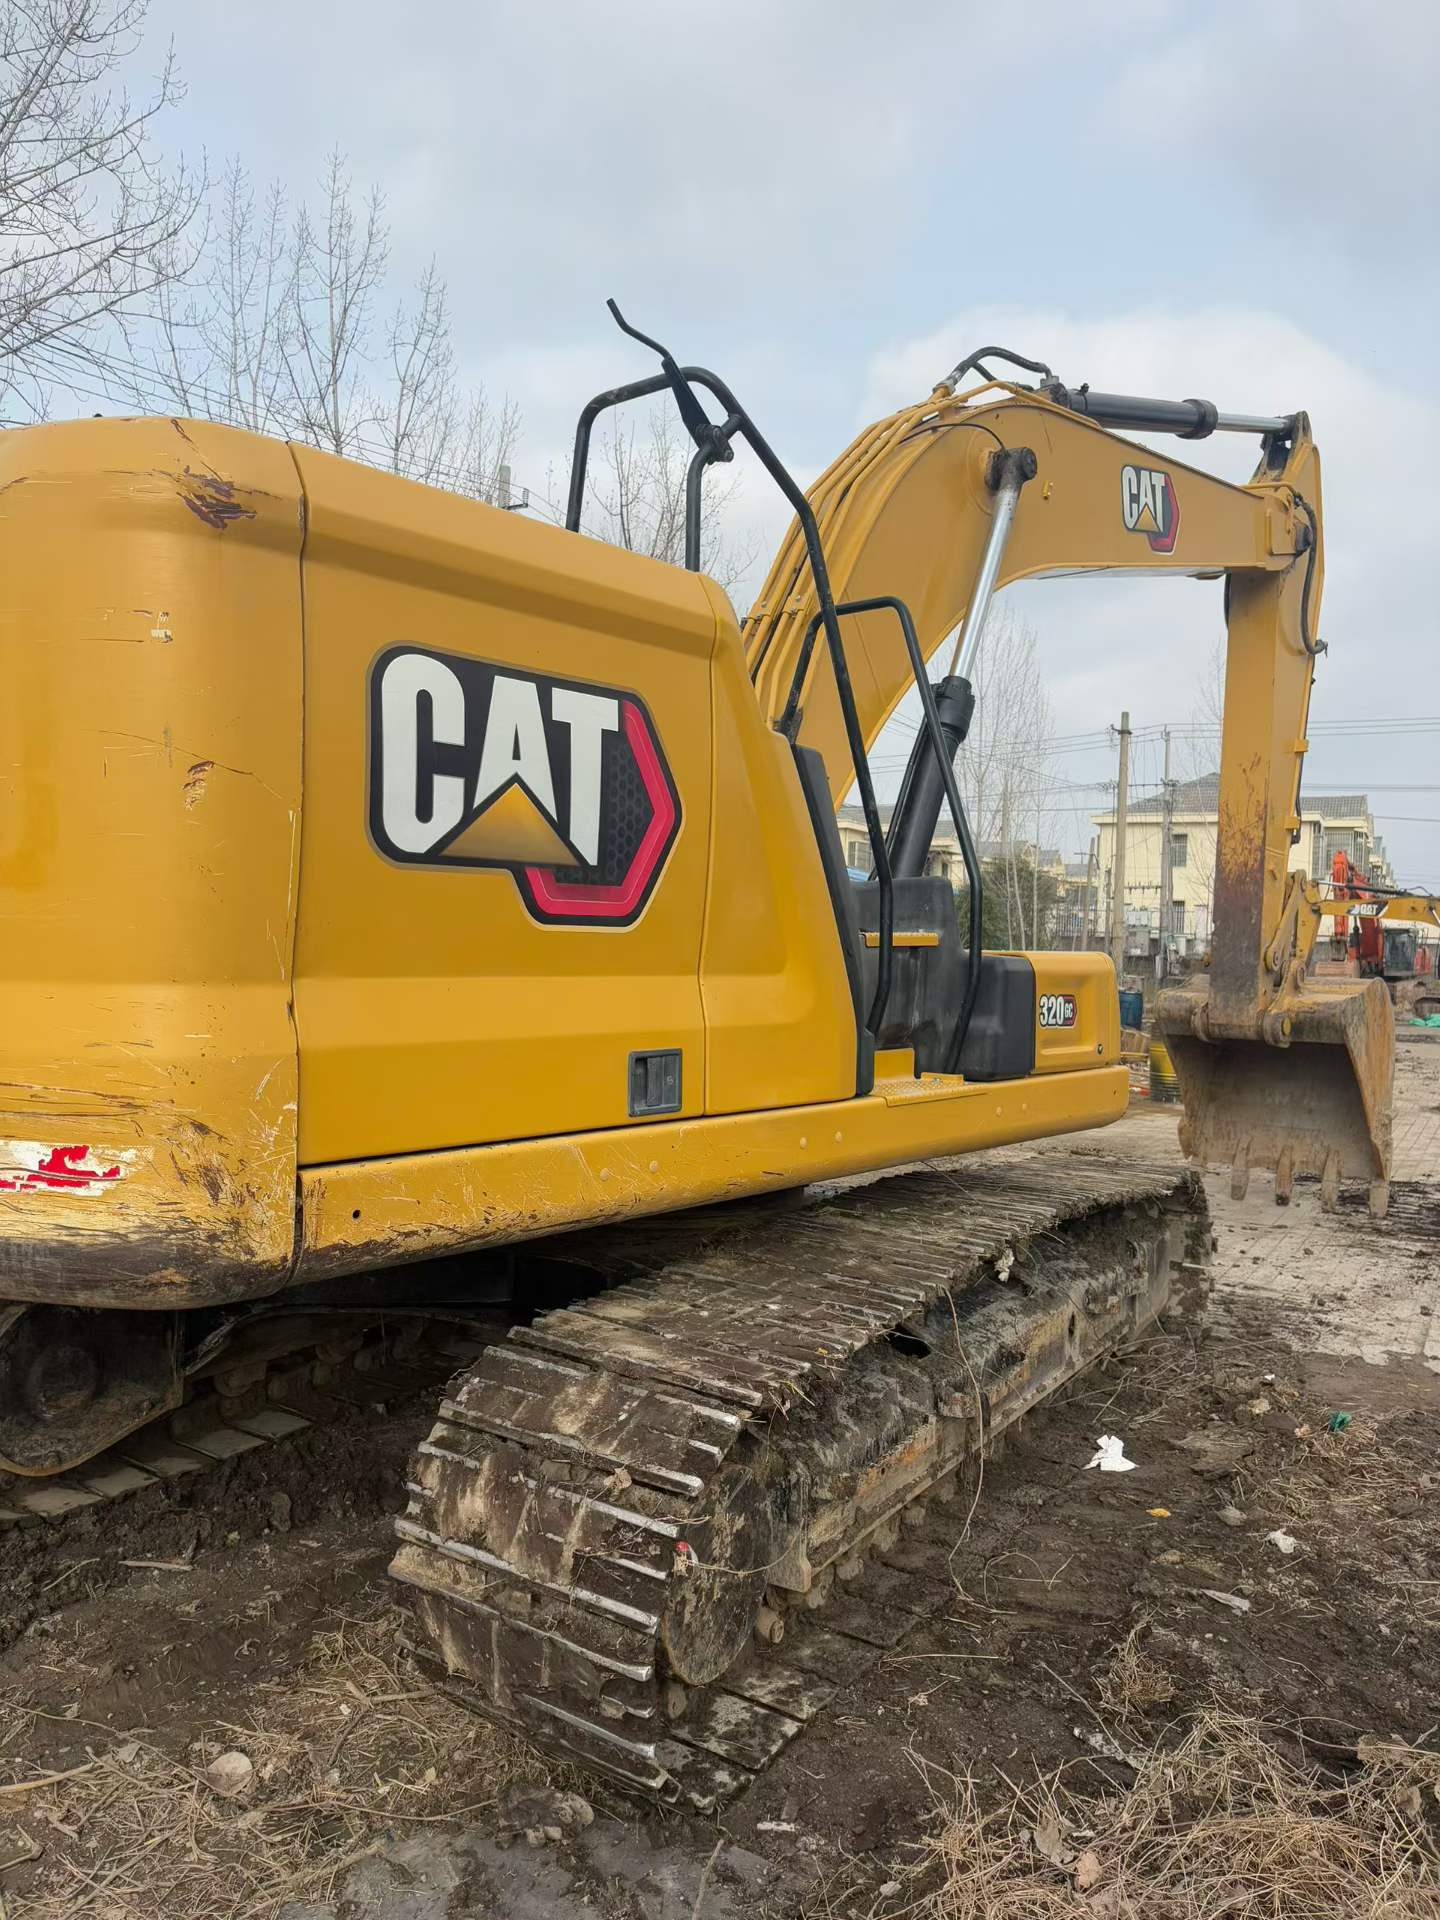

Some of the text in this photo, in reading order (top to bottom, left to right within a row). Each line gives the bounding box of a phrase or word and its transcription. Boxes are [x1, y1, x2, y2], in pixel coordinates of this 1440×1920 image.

[1122, 465, 1165, 532] CAT
[381, 653, 619, 866] CAT
[1040, 996, 1064, 1025] 320
